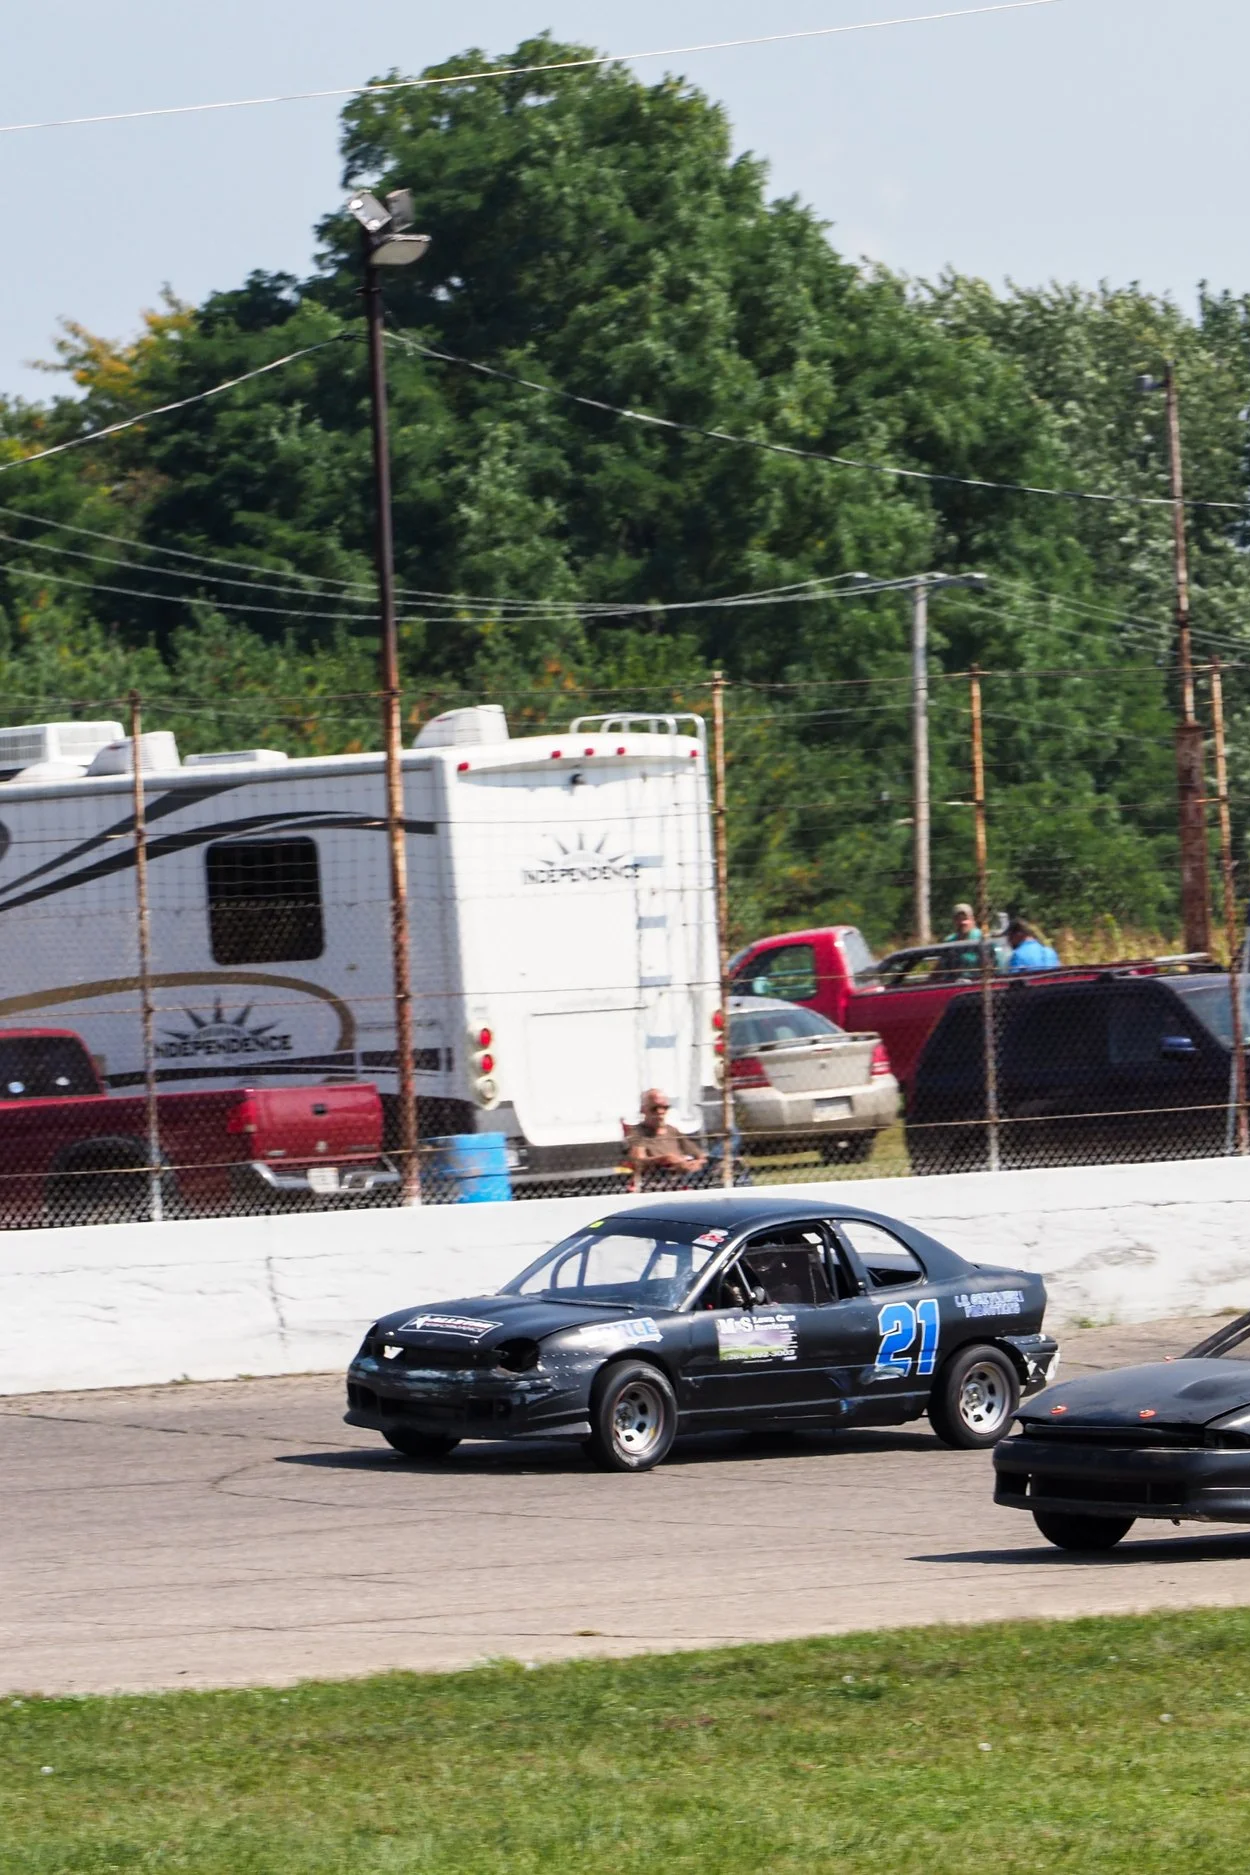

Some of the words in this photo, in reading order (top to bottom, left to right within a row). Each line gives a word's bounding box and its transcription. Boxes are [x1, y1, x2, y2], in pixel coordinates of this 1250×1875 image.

[523, 862, 640, 885] INDEPENDENCE
[154, 1034, 293, 1058] NDEPENDENCE
[874, 1298, 940, 1379] 21
